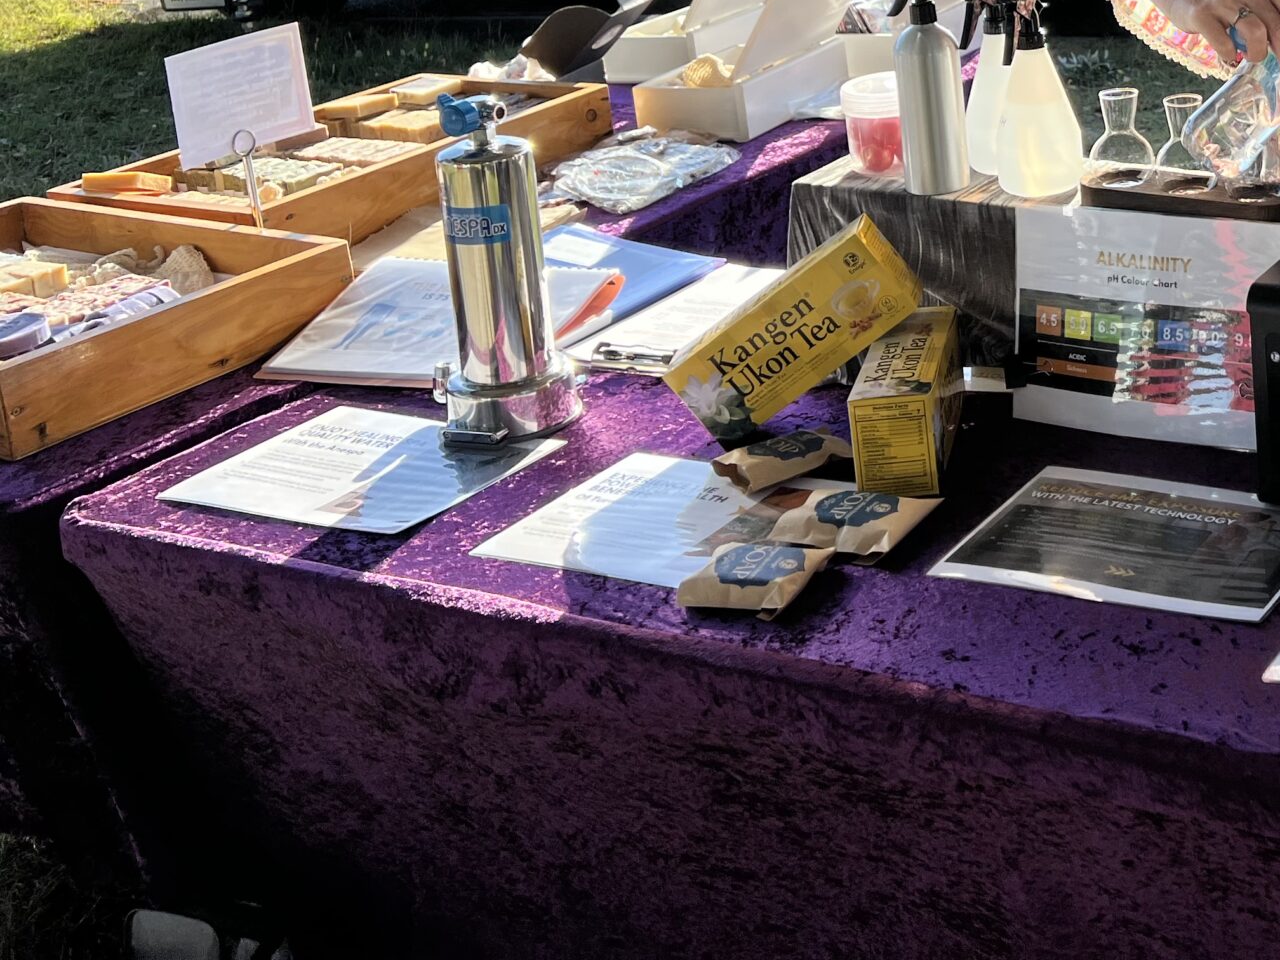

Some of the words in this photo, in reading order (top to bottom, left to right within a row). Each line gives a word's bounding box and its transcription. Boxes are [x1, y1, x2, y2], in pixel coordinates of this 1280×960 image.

[492, 222, 507, 236] DX
[1096, 250, 1192, 273] ALKALINITY
[1107, 275, 1119, 286] pH
[1121, 275, 1149, 287] Colour
[1153, 278, 1178, 289] Chart
[707, 296, 816, 377] Kangen
[1039, 313, 1059, 327] 4.5
[1069, 317, 1088, 332] 50
[1097, 320, 1118, 335] 6.5
[1163, 327, 1184, 342] 8.5
[725, 346, 800, 399] Ukon
[790, 314, 842, 351] Tea
[901, 337, 928, 355] Tea
[864, 341, 900, 385] Kangen
[891, 353, 922, 380] Ukon
[298, 429, 350, 444] QUALITY
[350, 435, 396, 450] WATER
[309, 423, 350, 435] ENJOY
[1031, 490, 1064, 503] WITH
[1066, 495, 1092, 505] THE
[1093, 498, 1142, 513] LATEST
[1143, 505, 1238, 526] TECHNOLOGY
[1147, 496, 1242, 519] EXPOSURE
[733, 544, 772, 580] SOAP
